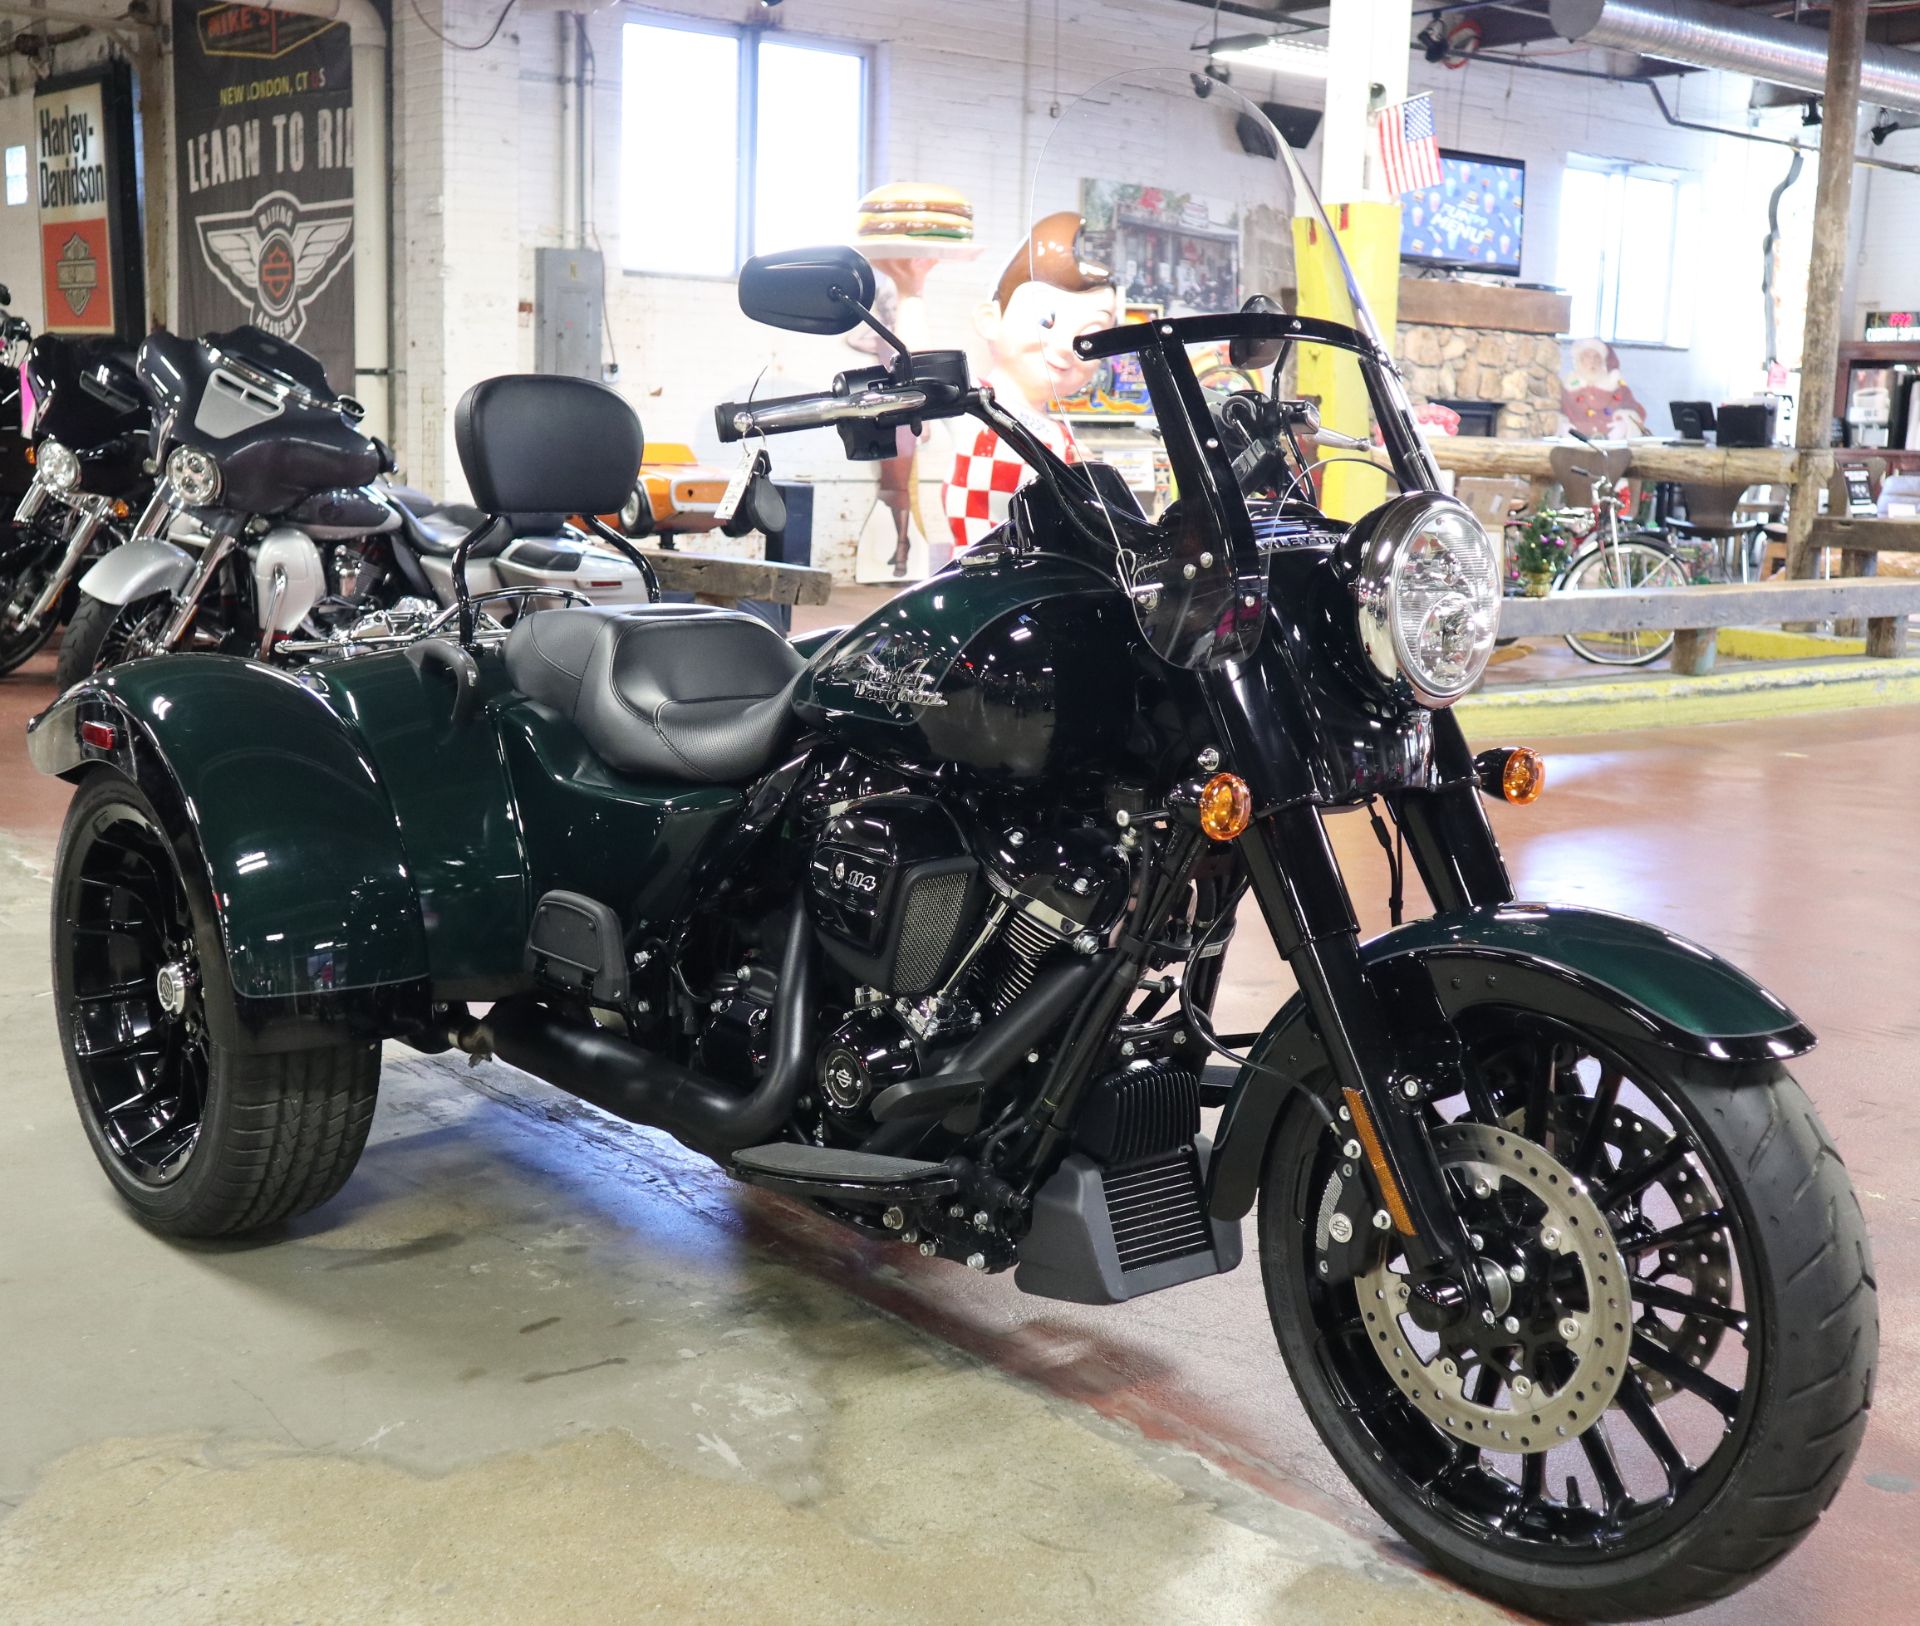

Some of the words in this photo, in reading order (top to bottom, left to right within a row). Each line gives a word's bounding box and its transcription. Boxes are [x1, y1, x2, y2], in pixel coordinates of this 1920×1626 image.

[219, 84, 245, 106] NEW
[295, 71, 309, 92] CT
[40, 104, 94, 160] Harley-
[187, 118, 260, 194] LEARN
[272, 111, 304, 173] TO
[40, 156, 105, 208] Davidson
[848, 870, 877, 891] 114
